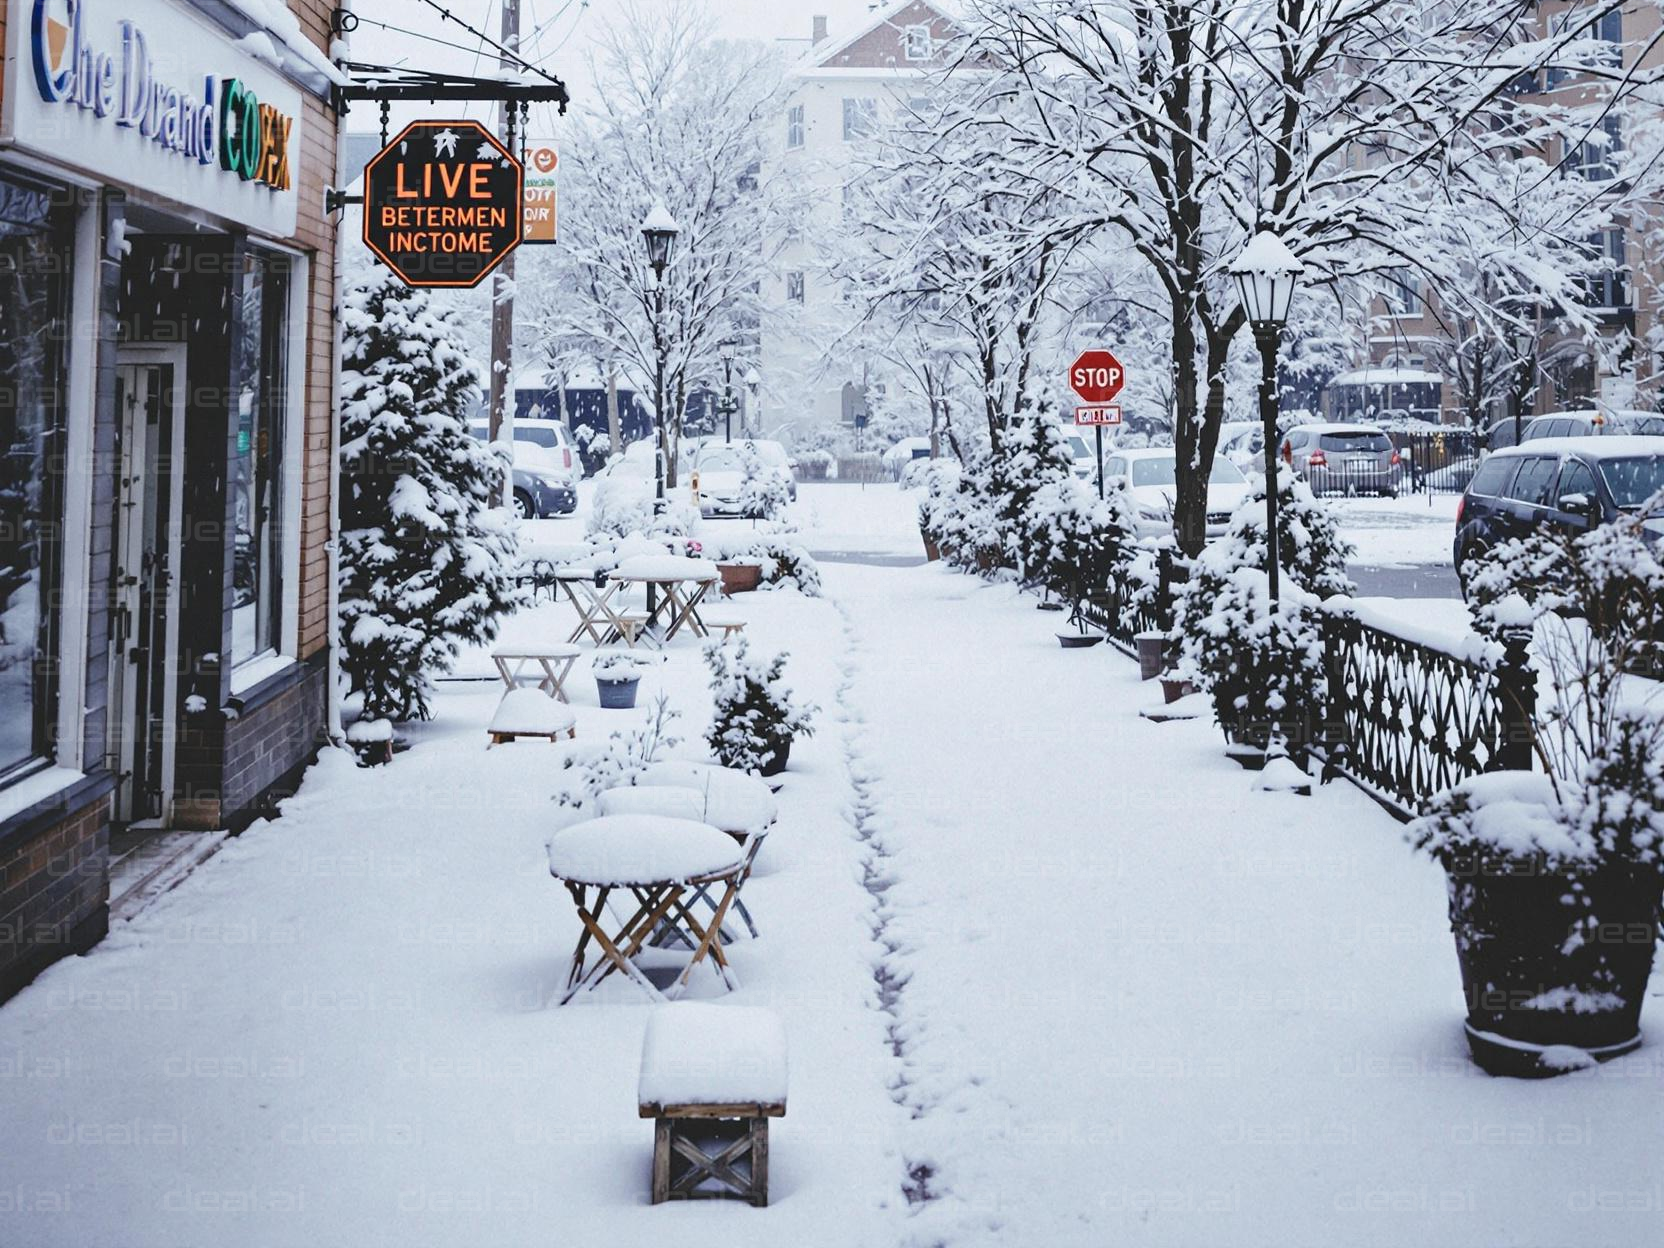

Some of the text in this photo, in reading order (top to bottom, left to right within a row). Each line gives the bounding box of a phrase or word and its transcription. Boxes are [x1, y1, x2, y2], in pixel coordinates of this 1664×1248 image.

[396, 162, 493, 198] LIVE
[381, 206, 506, 227] BETERMEN
[389, 232, 493, 253] INCTOME
[1074, 367, 1120, 388] STOP
